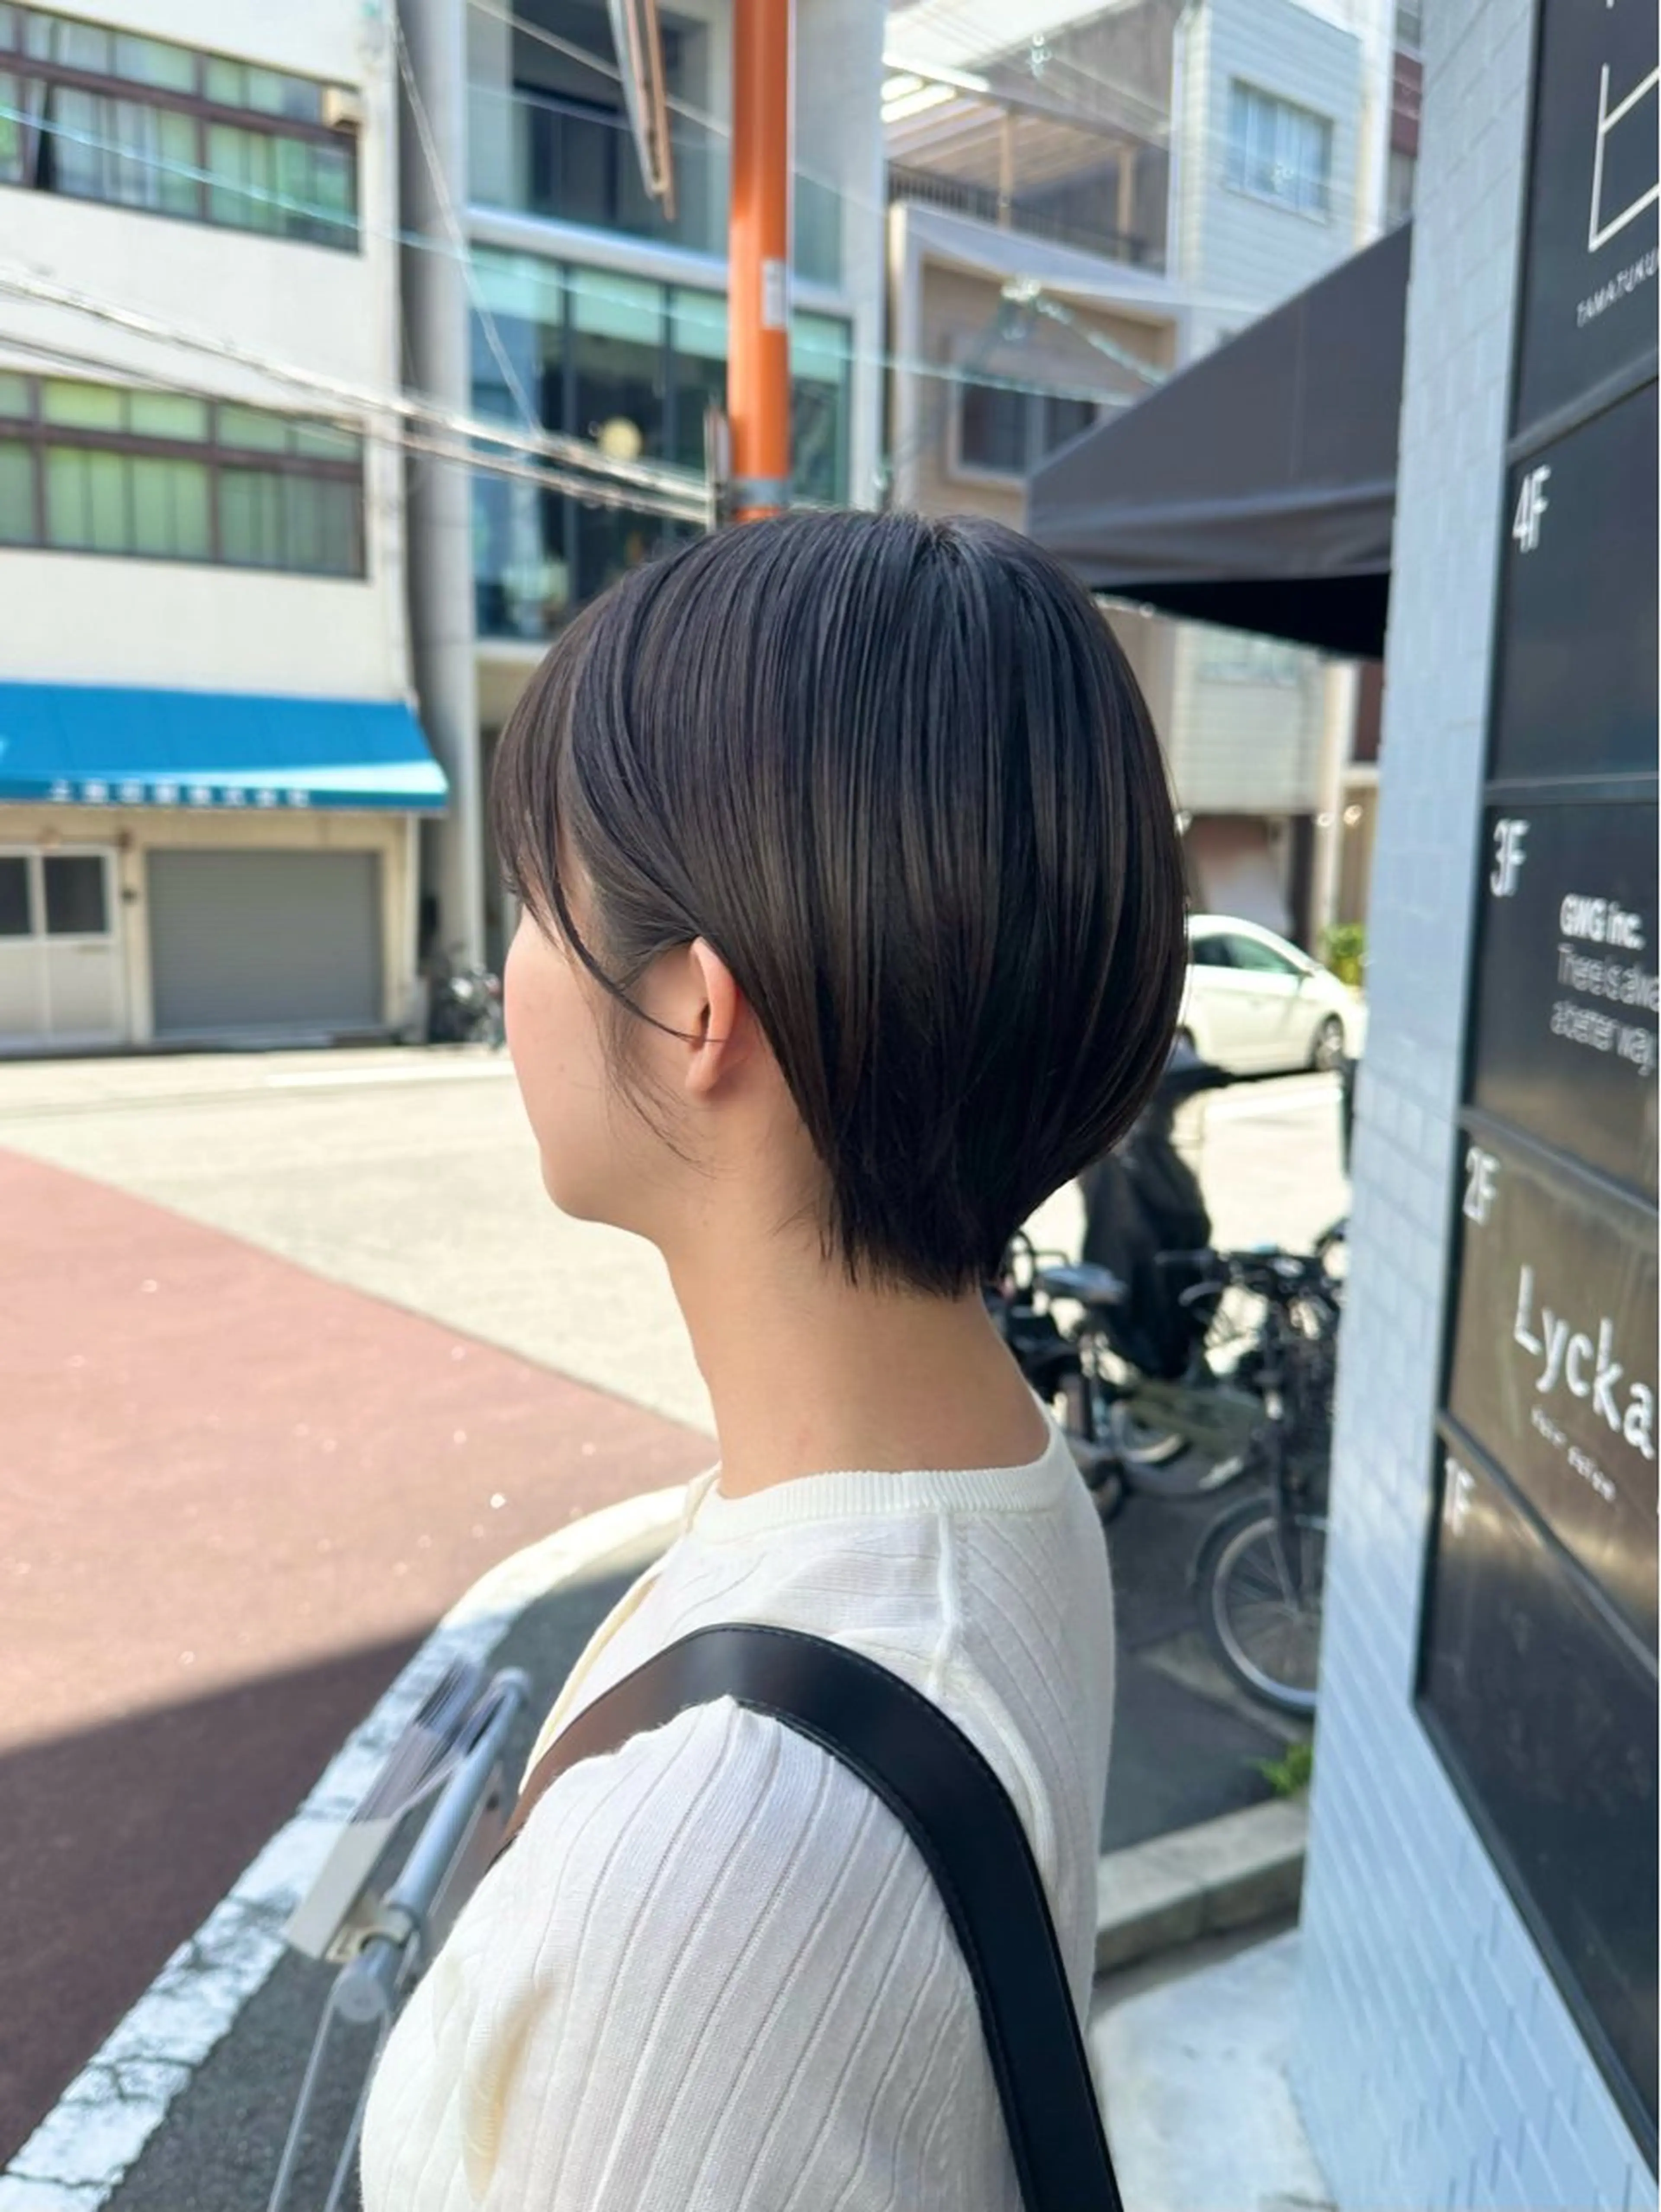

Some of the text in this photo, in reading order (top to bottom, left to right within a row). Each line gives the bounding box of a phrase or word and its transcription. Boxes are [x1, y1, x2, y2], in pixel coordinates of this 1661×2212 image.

[1512, 464, 1552, 554] 4F
[1490, 818, 1530, 898] 3F
[1462, 1145, 1501, 1226] 2F
[1513, 1264, 1655, 1460] Lycka
